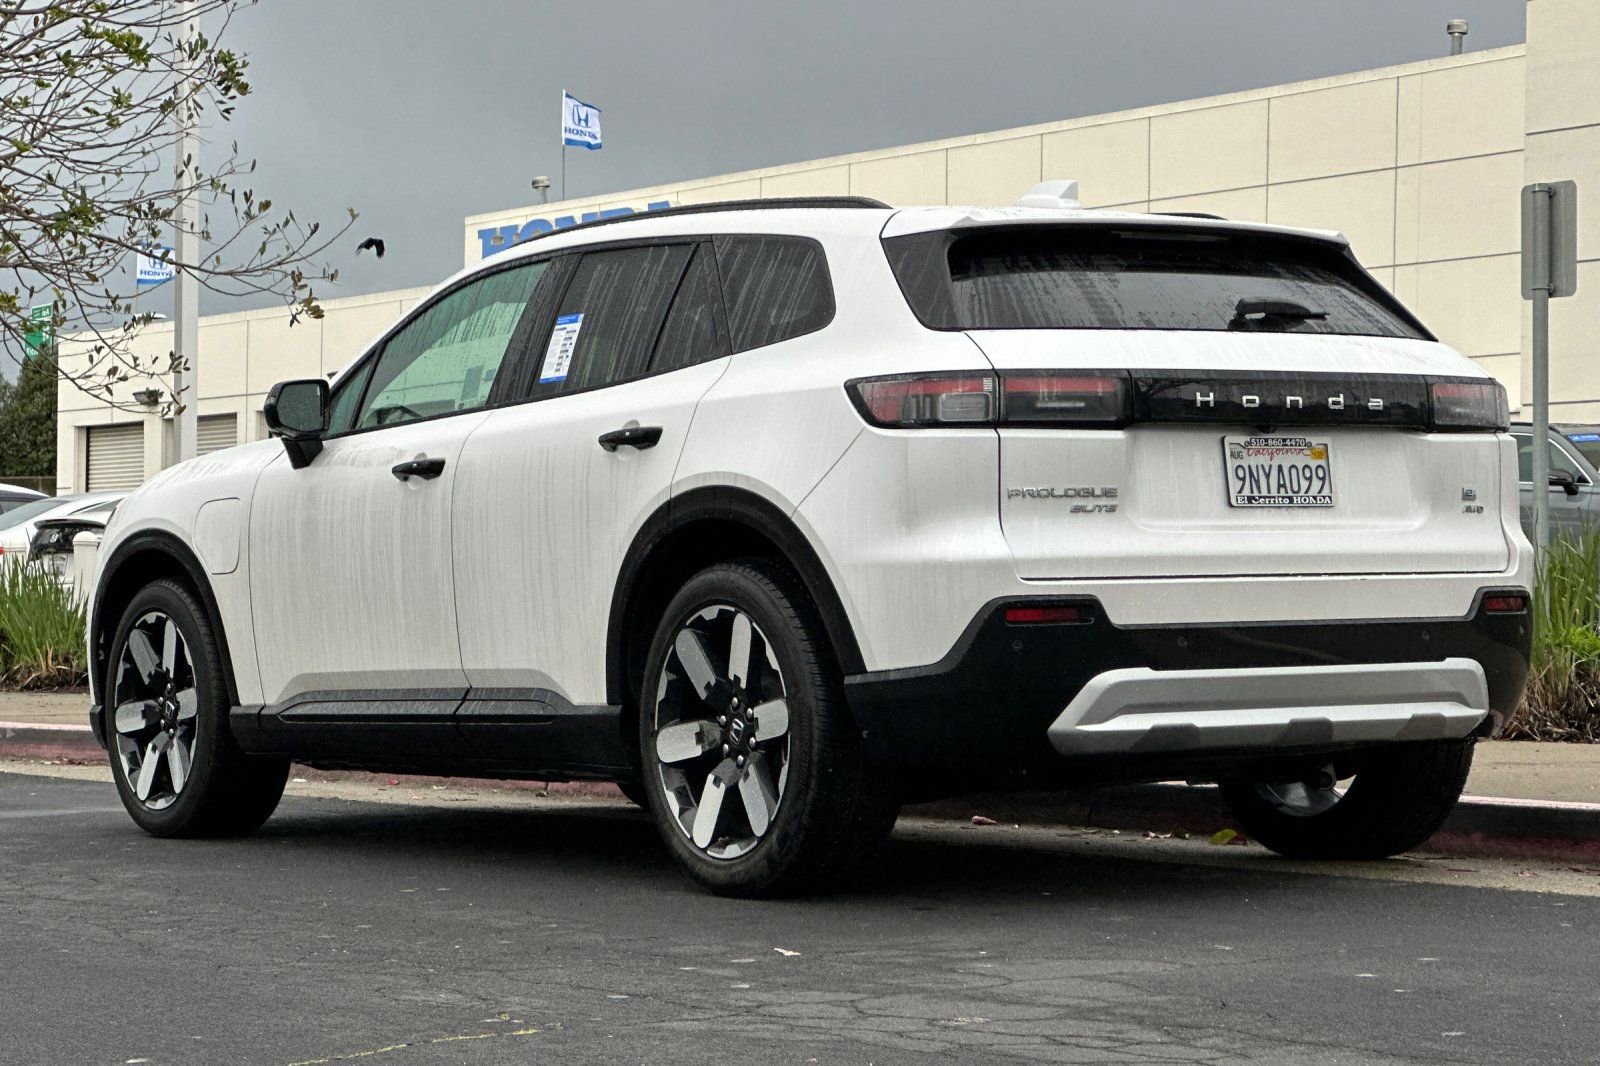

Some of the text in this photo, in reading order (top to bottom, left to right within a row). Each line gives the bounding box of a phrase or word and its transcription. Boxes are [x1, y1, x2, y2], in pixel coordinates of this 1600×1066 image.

[1195, 392, 1384, 411] Honda
[1251, 439, 1305, 447] 510-860-4470
[1230, 450, 1244, 459] AUG
[1246, 448, 1311, 461] California
[1234, 463, 1327, 495] 9NYA099
[1007, 487, 1119, 500] PROLOGUE
[1237, 495, 1332, 504] El Cerrito HONDA
[1069, 504, 1118, 513] ELITE
